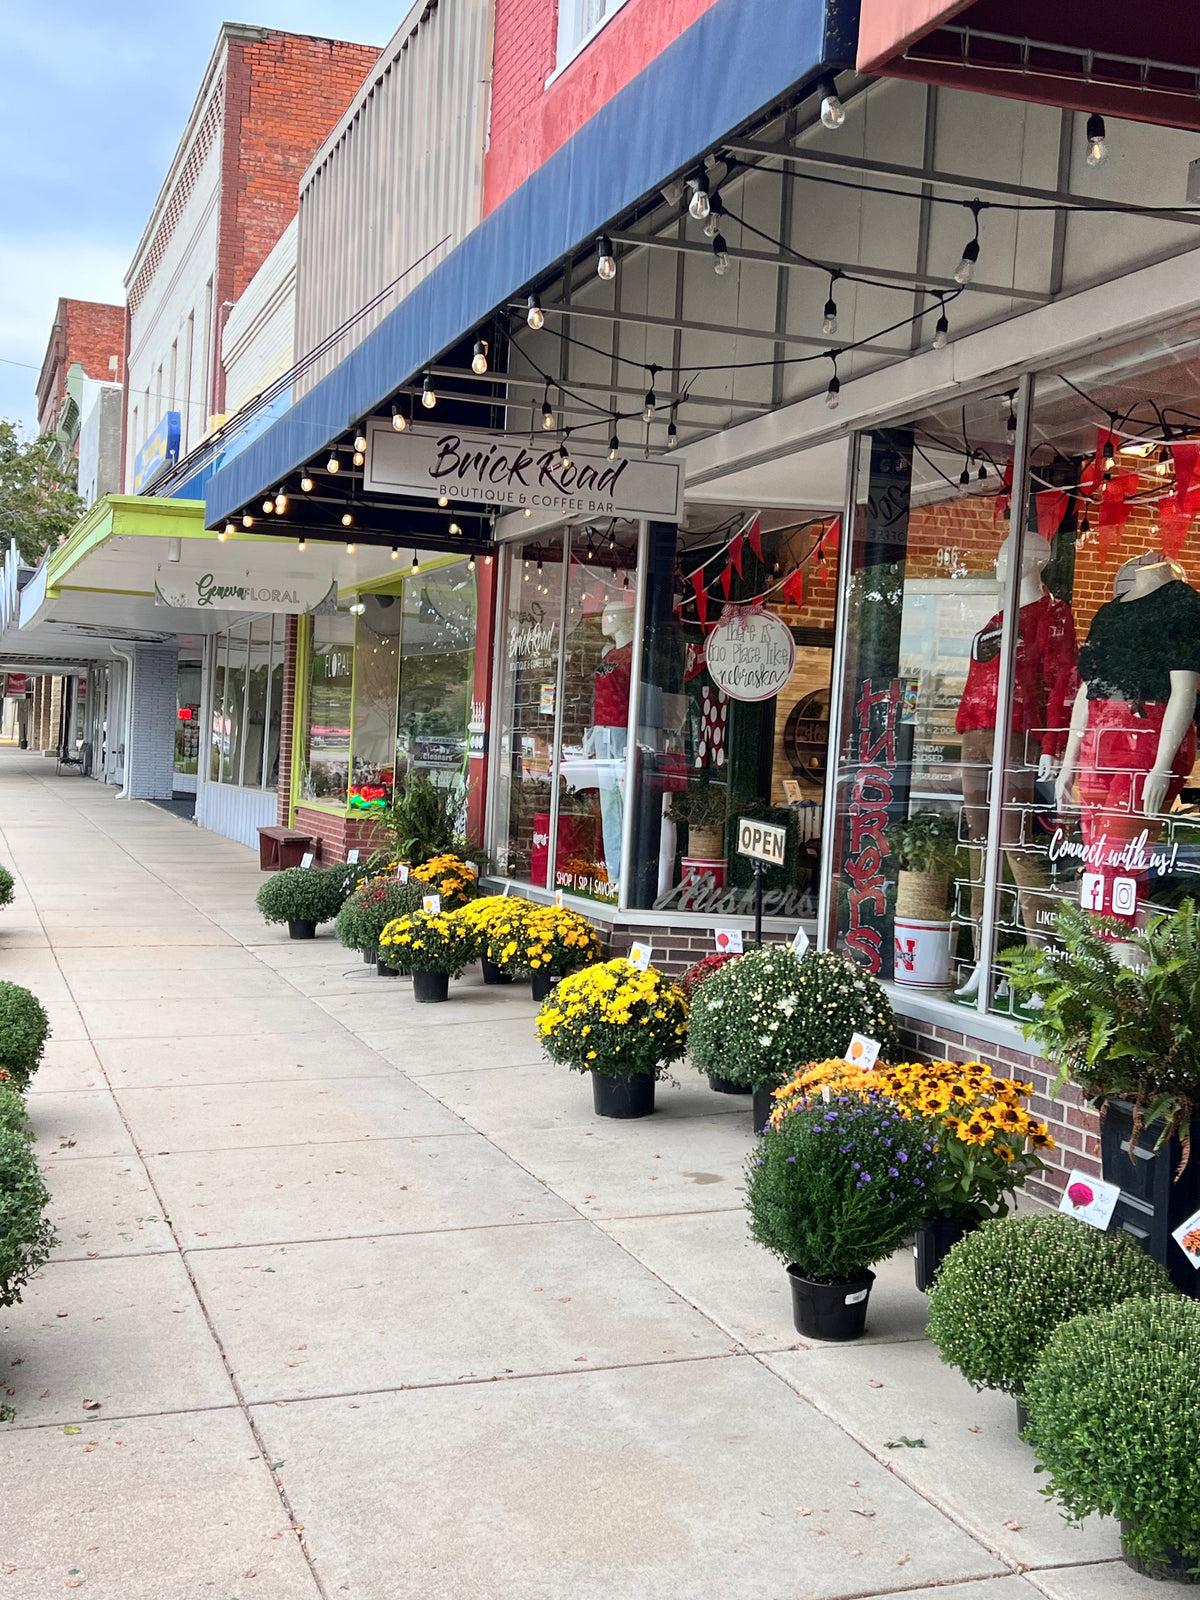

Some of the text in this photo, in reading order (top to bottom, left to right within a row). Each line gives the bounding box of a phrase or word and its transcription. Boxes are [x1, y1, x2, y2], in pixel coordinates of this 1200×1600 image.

[428, 434, 629, 497] Brick Road
[439, 484, 614, 513] BOUTIQUE & COFFEE BAR
[195, 573, 300, 606] Geneva FLORAL
[325, 653, 350, 678] FLORAL
[711, 644, 726, 662] no
[717, 663, 786, 688] nebraska
[741, 826, 783, 859] OPEN
[1048, 828, 1179, 876] Connect with us!
[556, 871, 572, 887] SHOP
[578, 876, 588, 890] SIP
[594, 879, 616, 898] SAVOR
[652, 867, 816, 917] Huskers
[1036, 910, 1057, 925] LIKE
